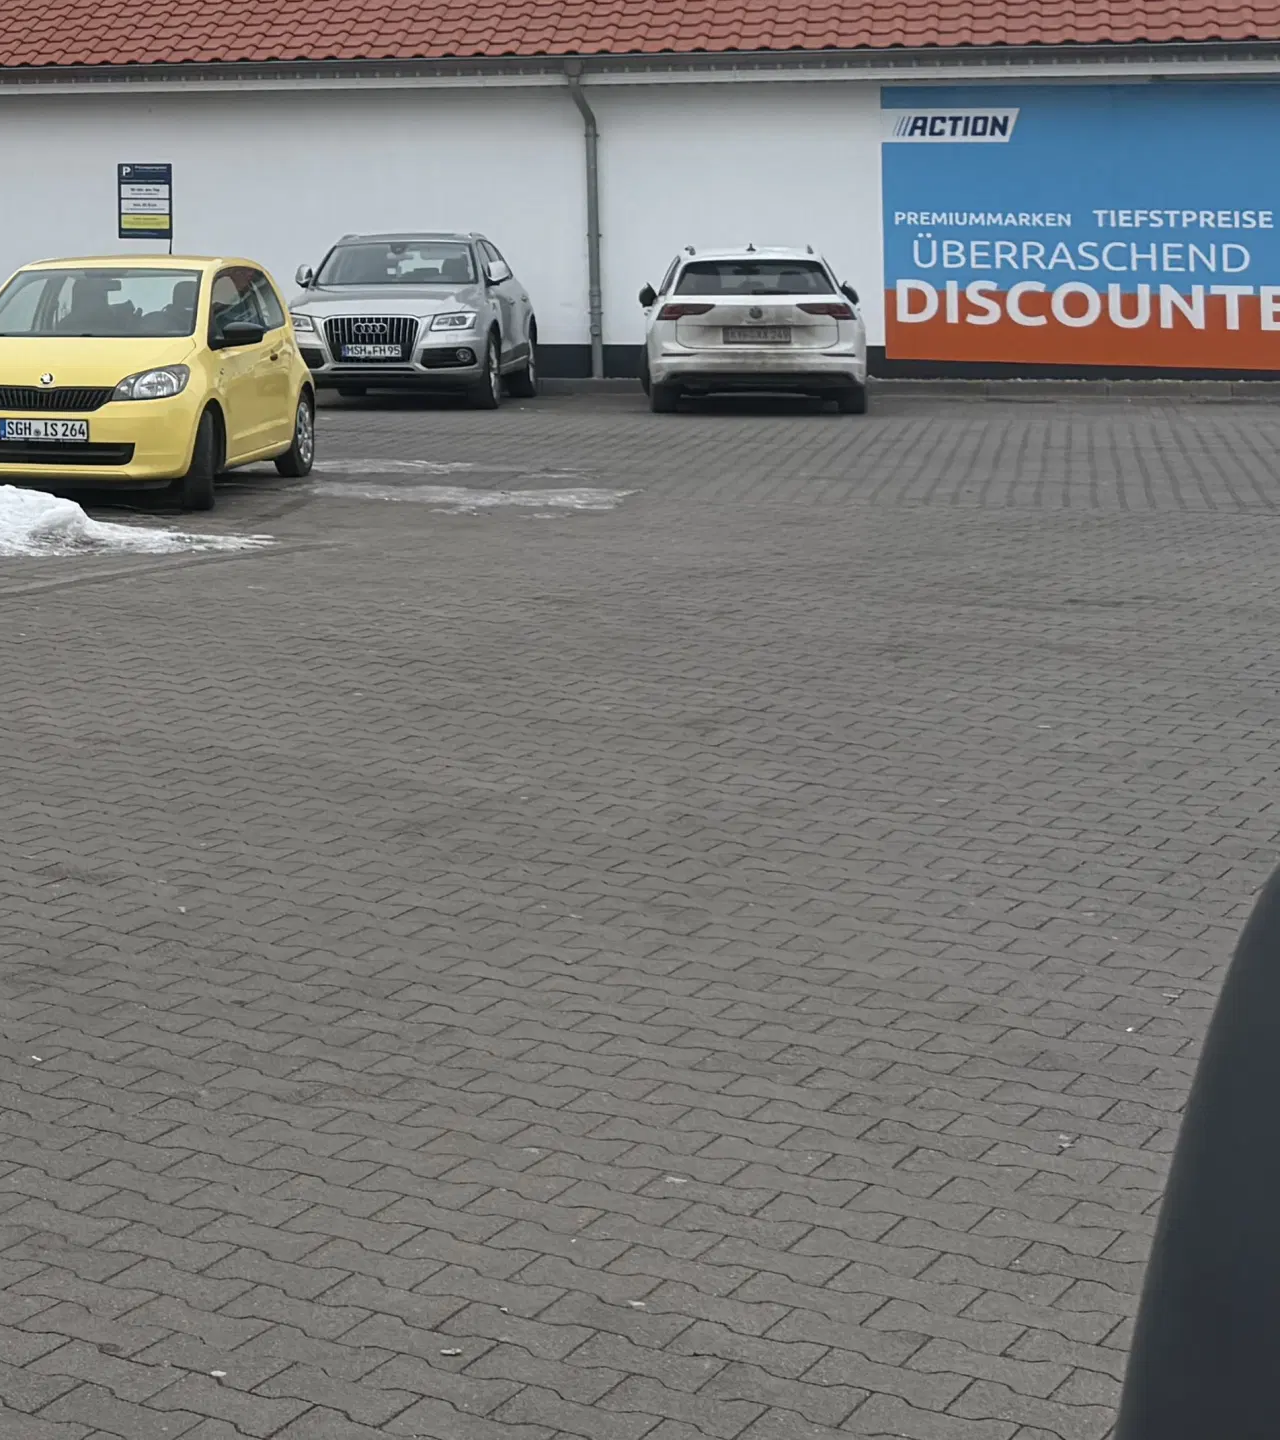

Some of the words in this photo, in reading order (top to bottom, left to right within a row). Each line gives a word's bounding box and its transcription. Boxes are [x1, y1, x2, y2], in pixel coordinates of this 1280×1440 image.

[908, 115, 1009, 137] ACTION
[122, 166, 131, 177] P
[894, 211, 1072, 227] PREMIUMMARKEN
[1092, 209, 1274, 229] TIEFSTPREISE
[913, 232, 1250, 273] ÜBERRASCHEND
[7, 421, 32, 436] SGH
[43, 422, 58, 437] IS
[61, 423, 86, 437] 264
